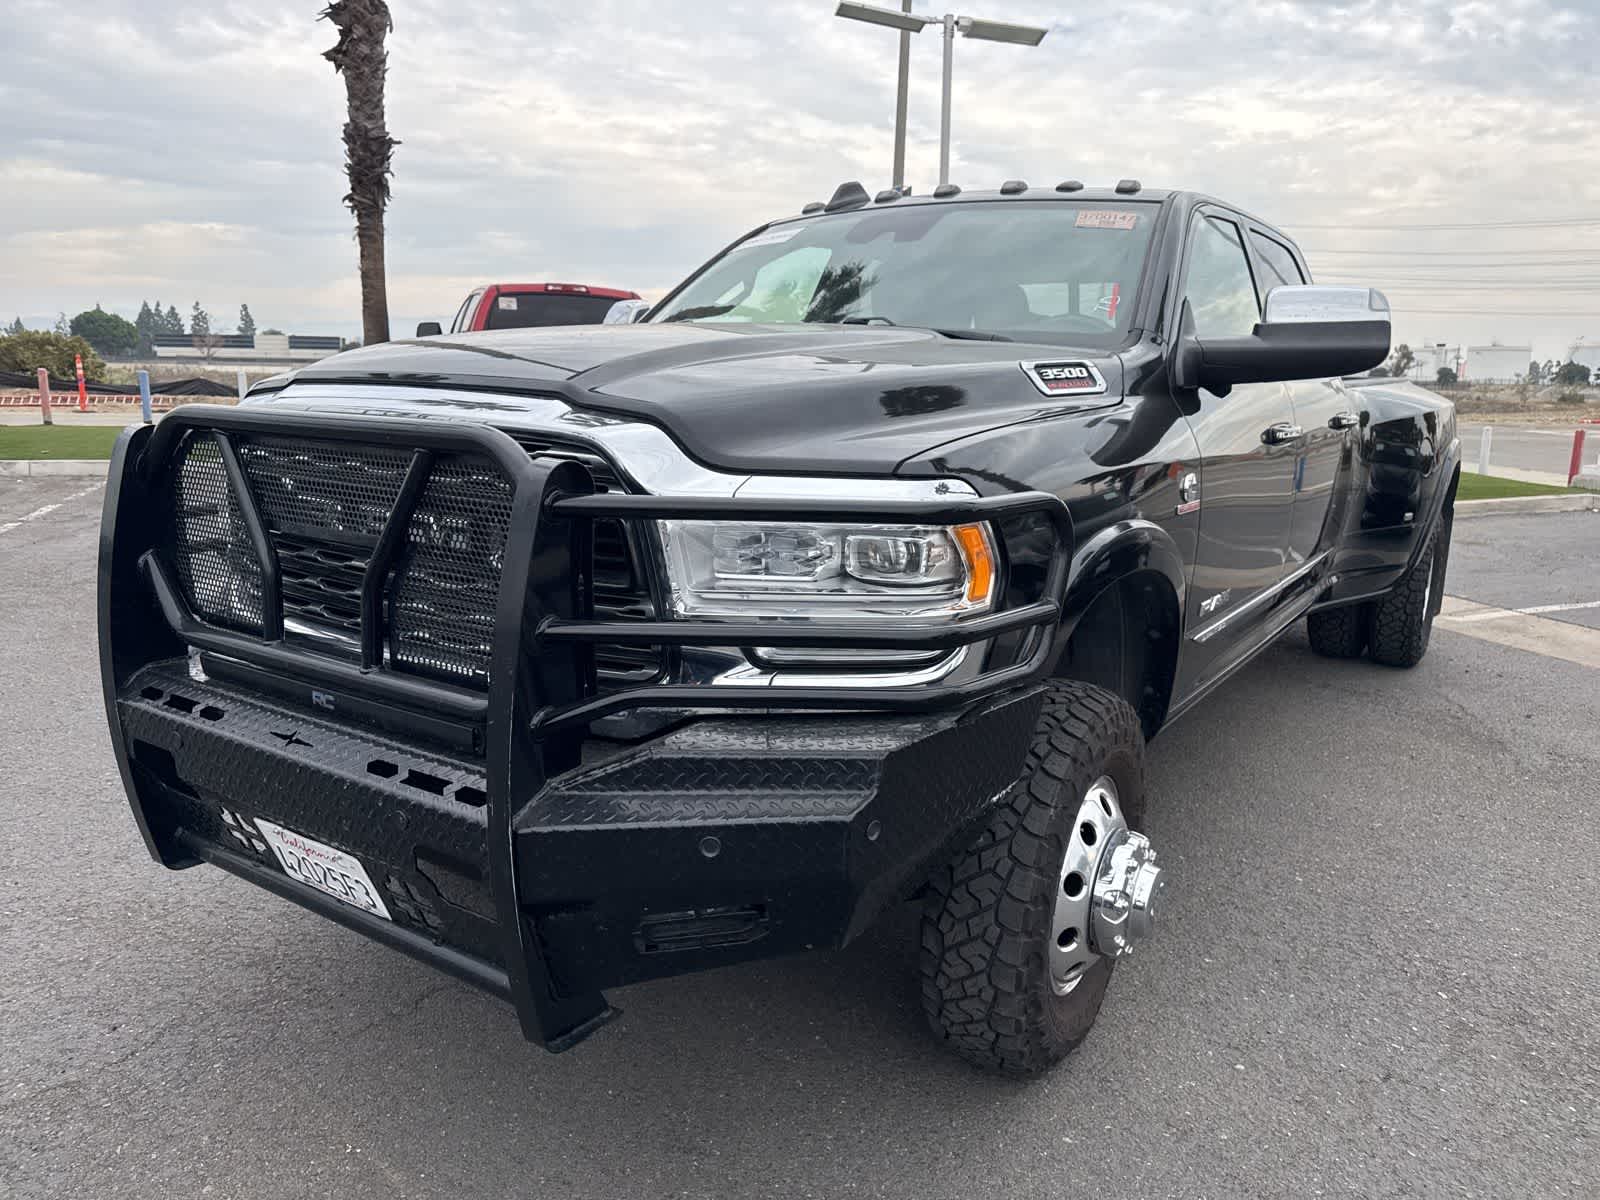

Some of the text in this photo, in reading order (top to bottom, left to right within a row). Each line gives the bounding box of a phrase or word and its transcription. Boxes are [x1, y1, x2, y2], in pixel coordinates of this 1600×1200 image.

[1040, 367, 1089, 379] 3500
[312, 690, 335, 710] RC
[276, 845, 376, 909] 42025F3
